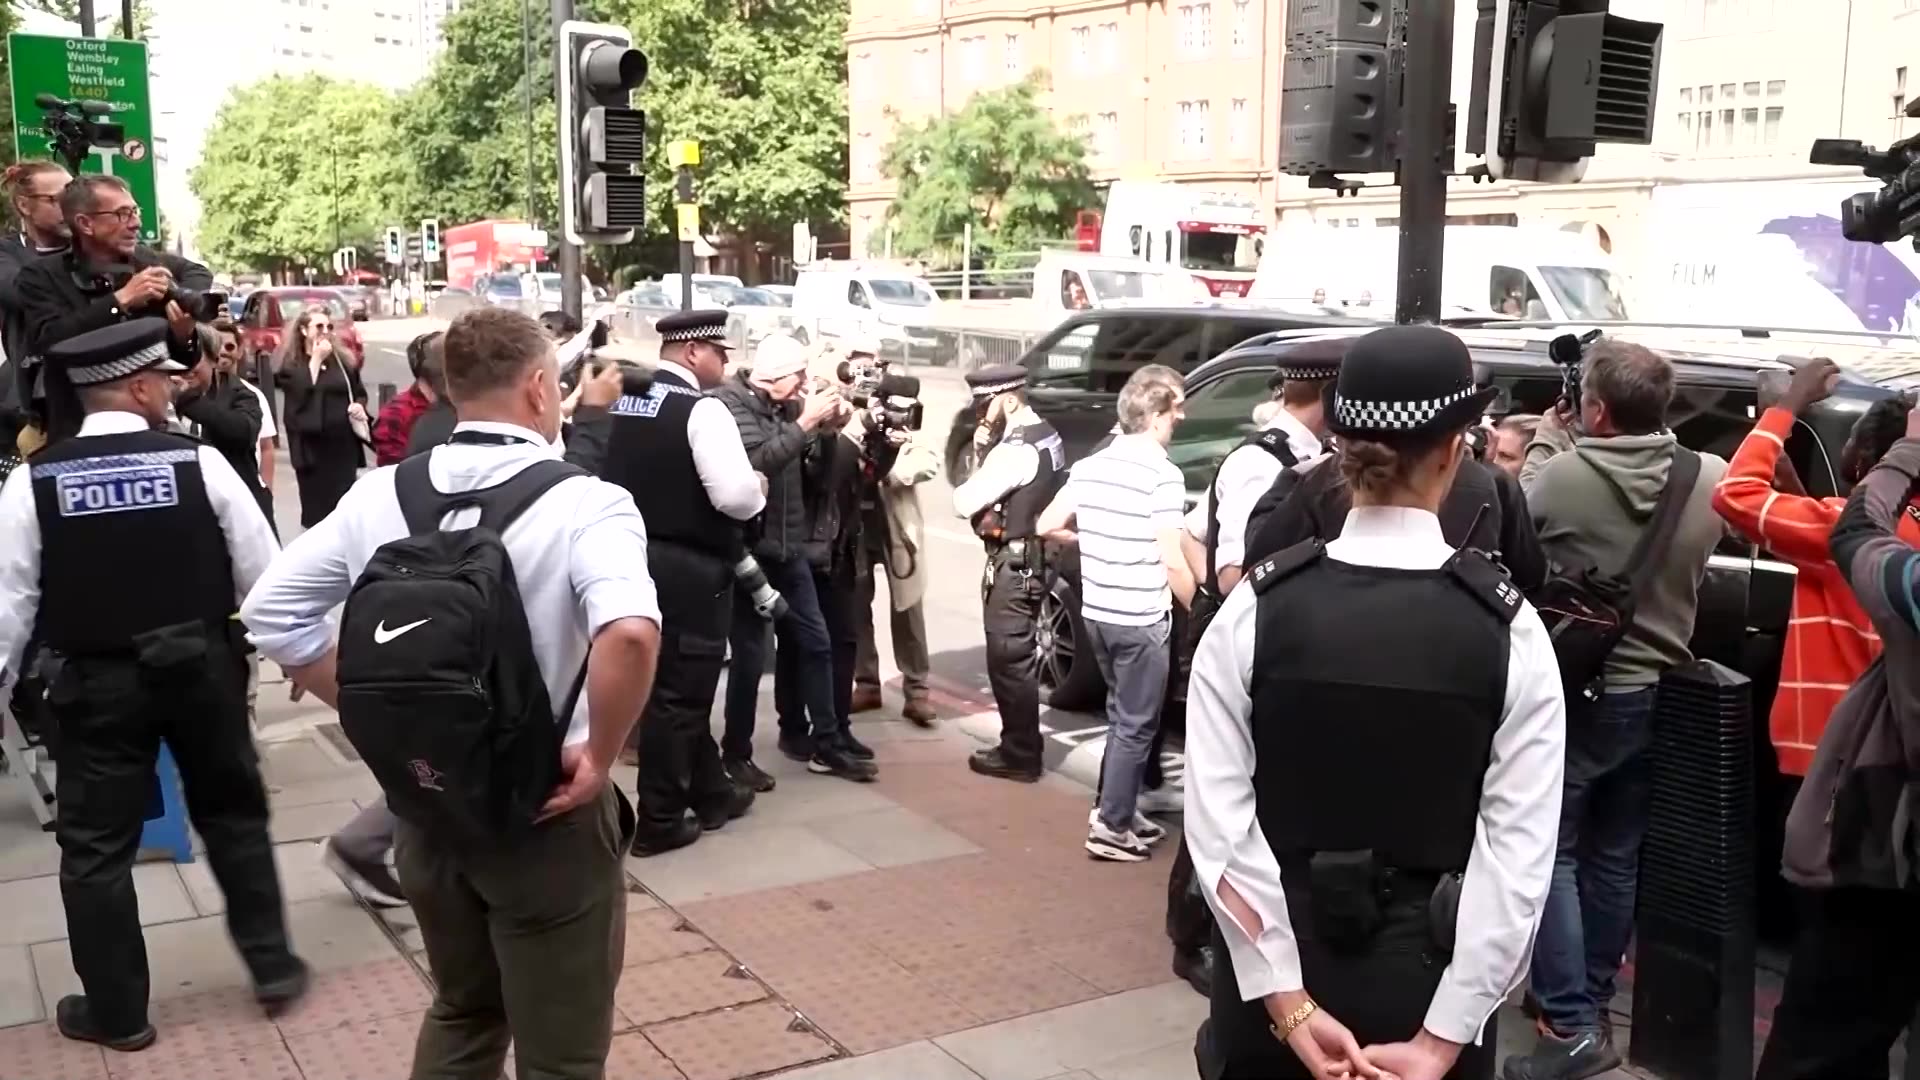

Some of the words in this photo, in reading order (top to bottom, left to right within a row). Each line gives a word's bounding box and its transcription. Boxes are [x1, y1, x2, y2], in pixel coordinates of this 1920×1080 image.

[65, 39, 107, 52] Oxford
[66, 51, 119, 66] Wembley
[67, 62, 104, 76] Ealing
[68, 73, 125, 87] Westfield
[69, 86, 108, 99] (A40)
[1672, 262, 1716, 286] FILM
[609, 394, 660, 414] OLICE
[63, 479, 173, 511] POLICE
